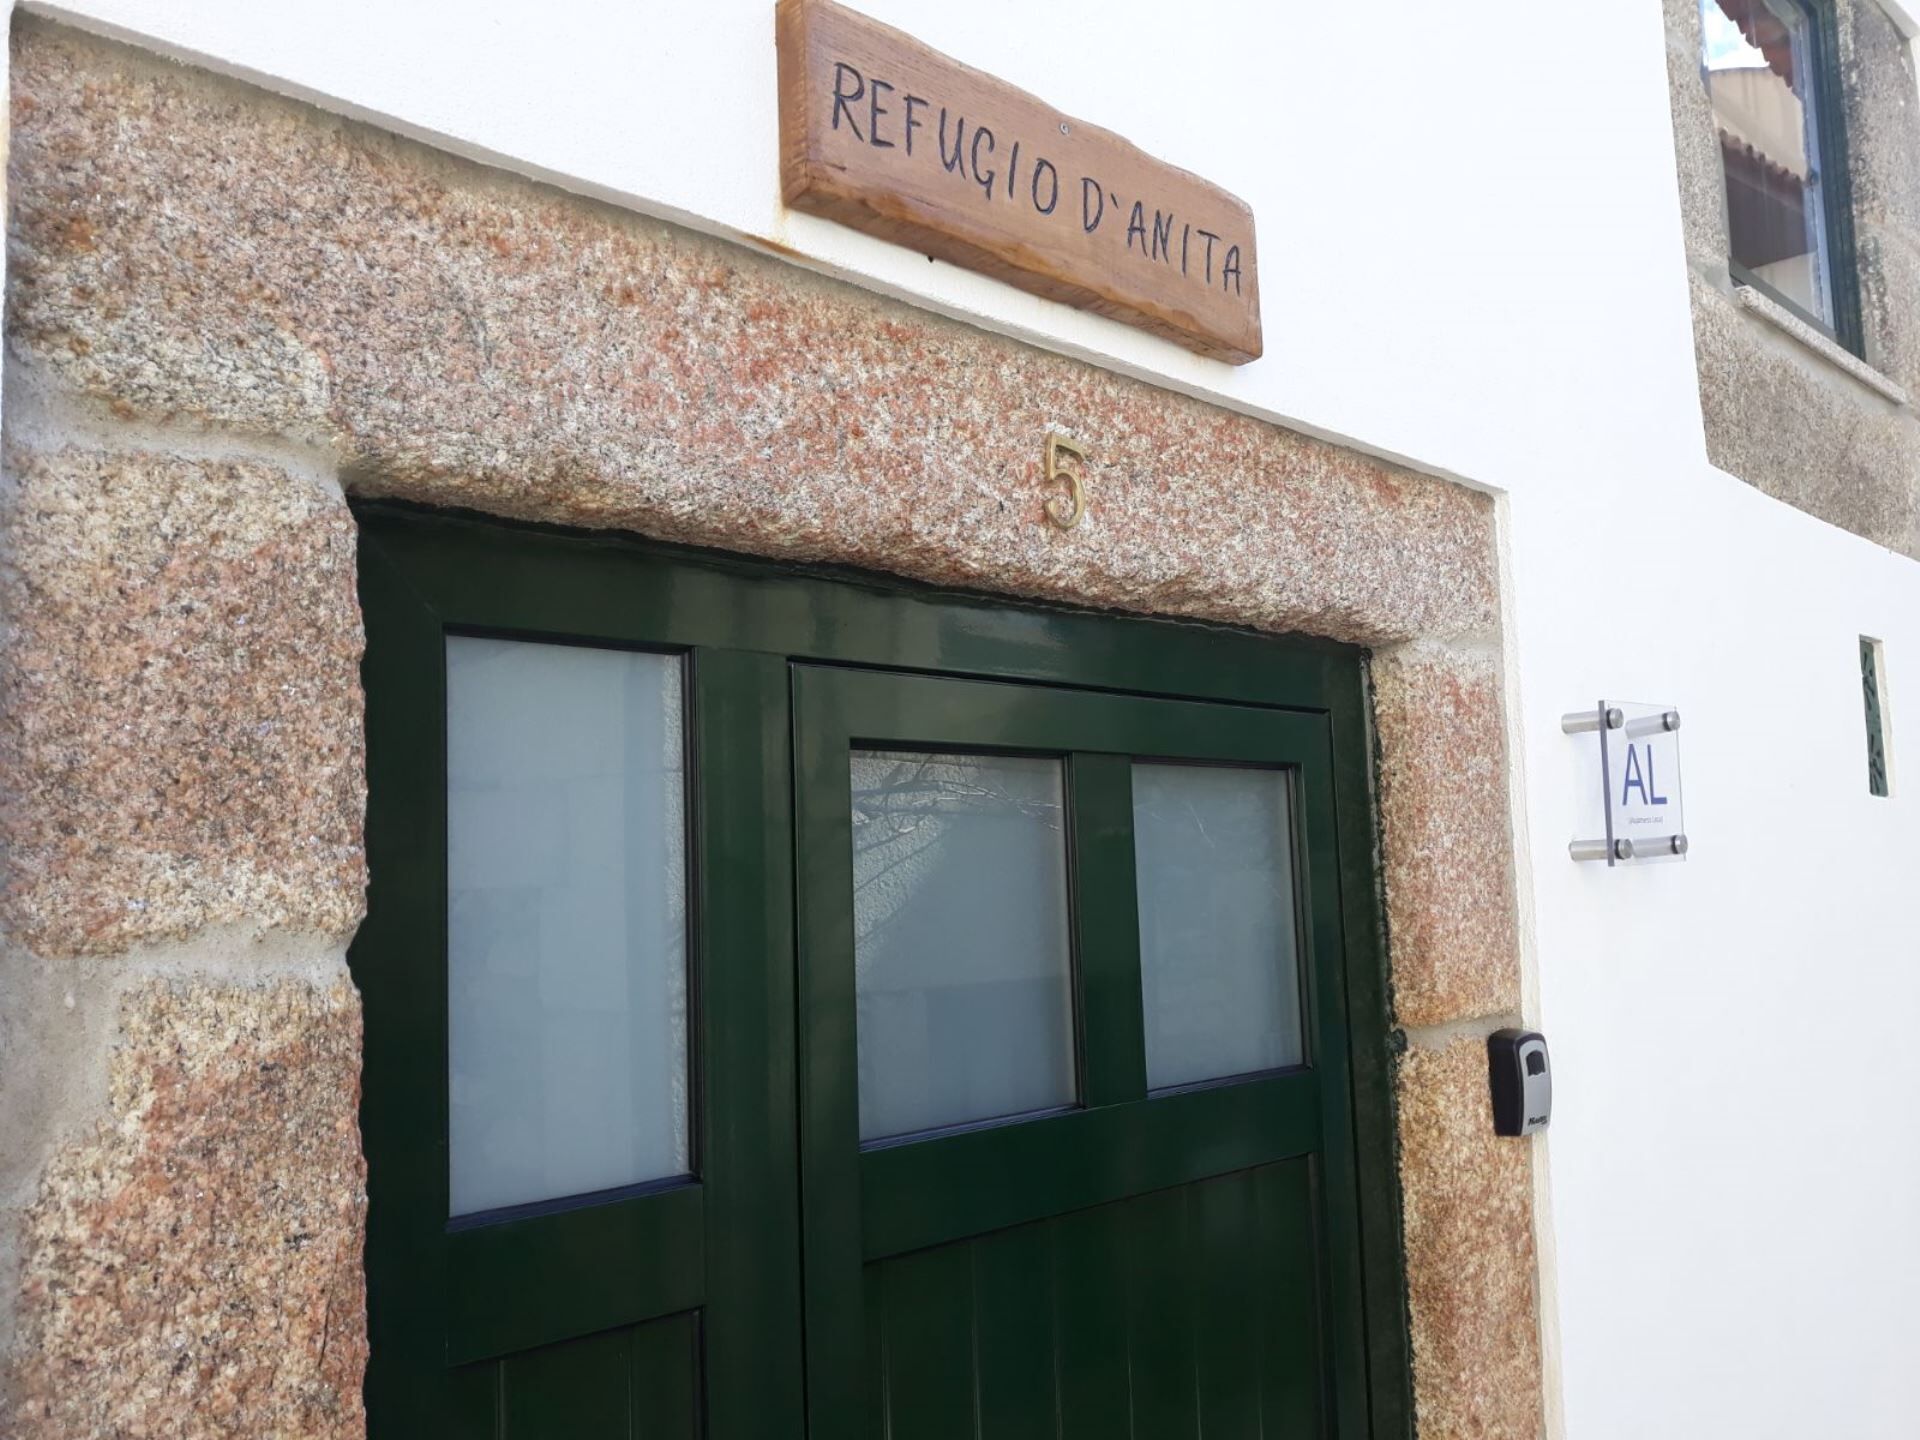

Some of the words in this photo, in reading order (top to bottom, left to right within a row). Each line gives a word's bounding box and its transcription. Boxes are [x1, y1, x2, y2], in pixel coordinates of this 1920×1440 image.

[832, 61, 1058, 216] REFUGIO
[1045, 432, 1085, 530] 5
[1622, 743, 1667, 805] AL
